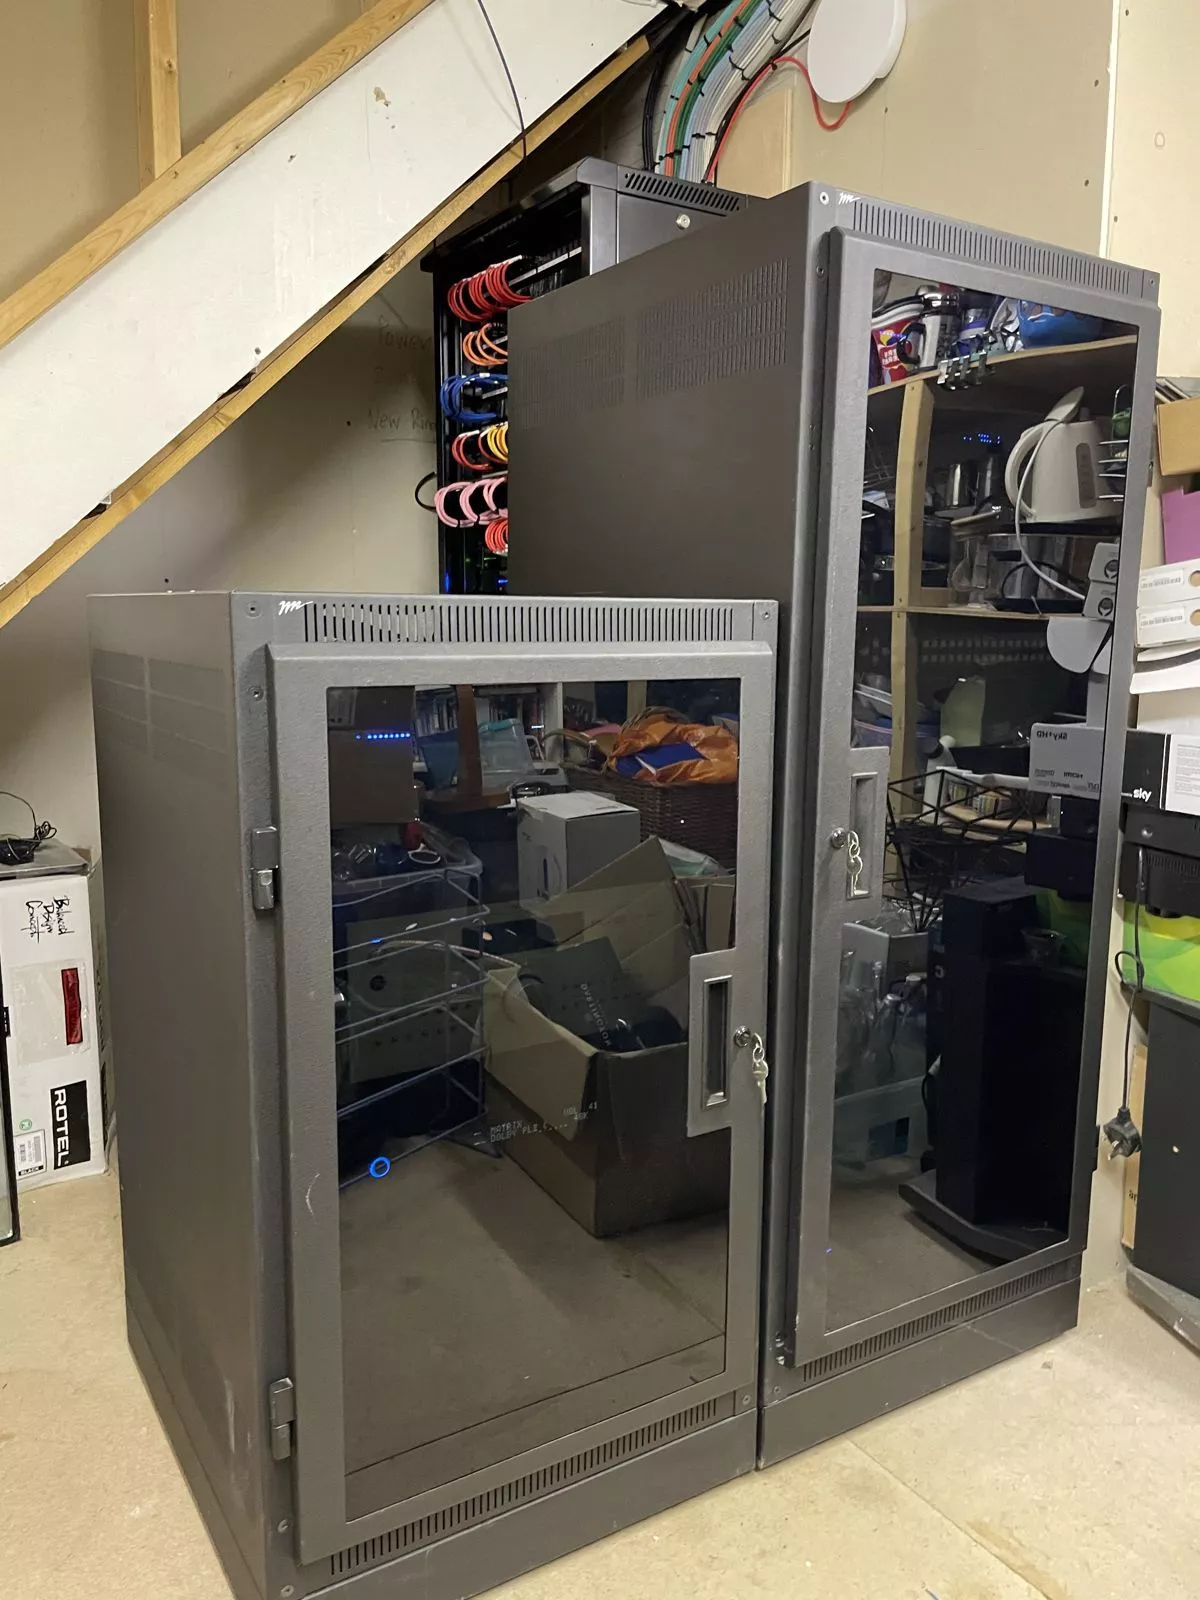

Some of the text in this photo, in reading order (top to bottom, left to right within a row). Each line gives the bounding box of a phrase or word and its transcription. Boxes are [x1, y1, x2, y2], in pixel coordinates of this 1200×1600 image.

[368, 408, 400, 430] New
[1133, 787, 1152, 802] sky
[54, 1088, 70, 1167] ROTEL
